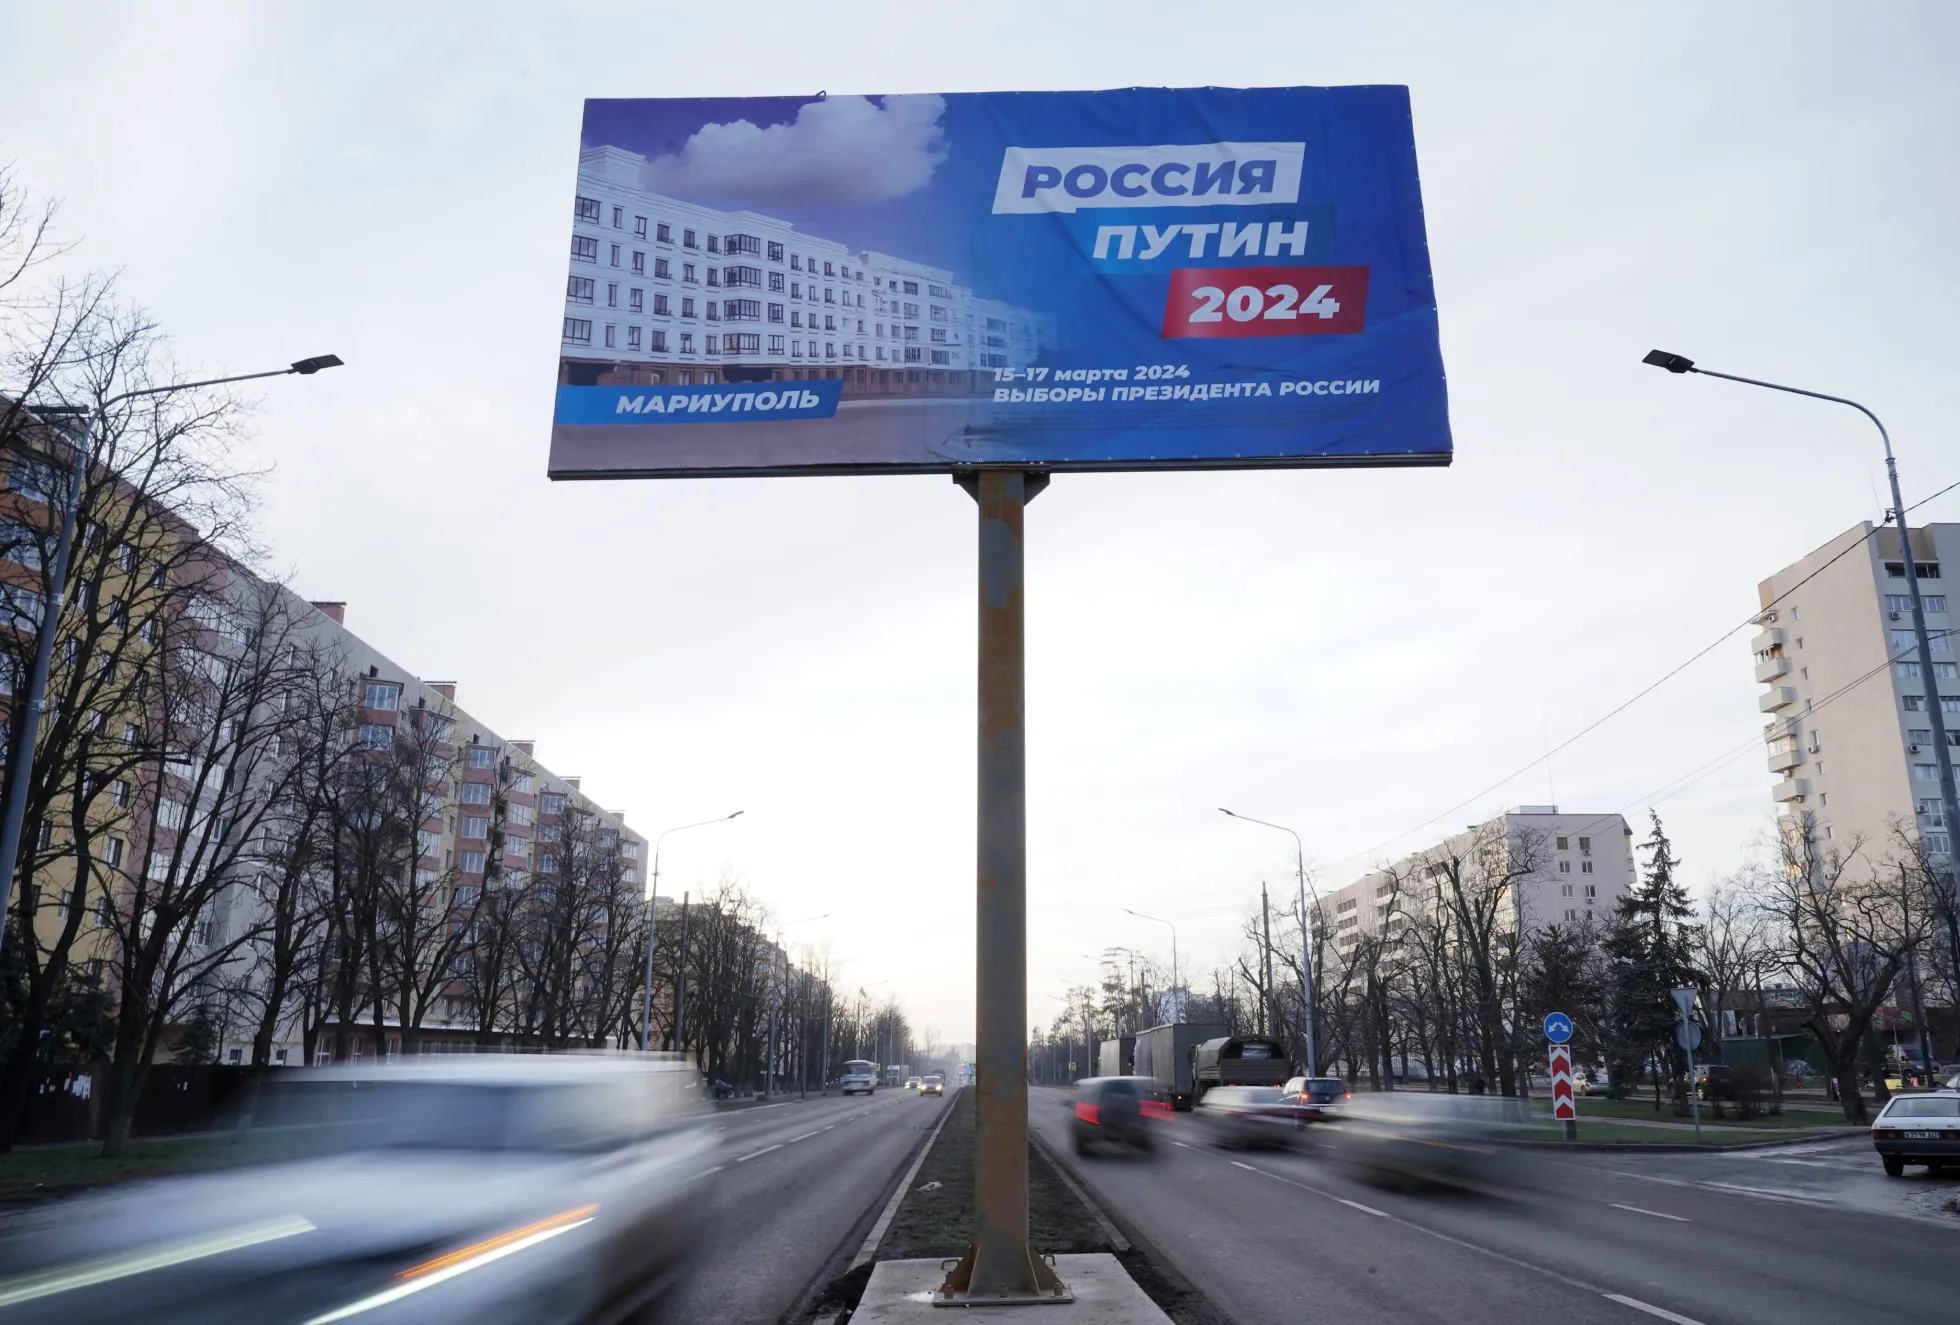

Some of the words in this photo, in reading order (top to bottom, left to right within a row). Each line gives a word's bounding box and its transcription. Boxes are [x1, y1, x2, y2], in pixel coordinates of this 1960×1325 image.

[1021, 159, 1278, 199] РОССИЯ
[1092, 221, 1309, 260] ПУТИН
[1188, 284, 1341, 324] 2024
[1054, 369, 1129, 384] марта
[1134, 364, 1191, 380] 2024
[615, 390, 820, 414] МАРИУПОЛЬ
[992, 387, 1106, 403] ВЫБОРЫ
[1111, 383, 1272, 402] ПРЕЗИДЕНТА
[1279, 379, 1380, 396] РОССИИ
